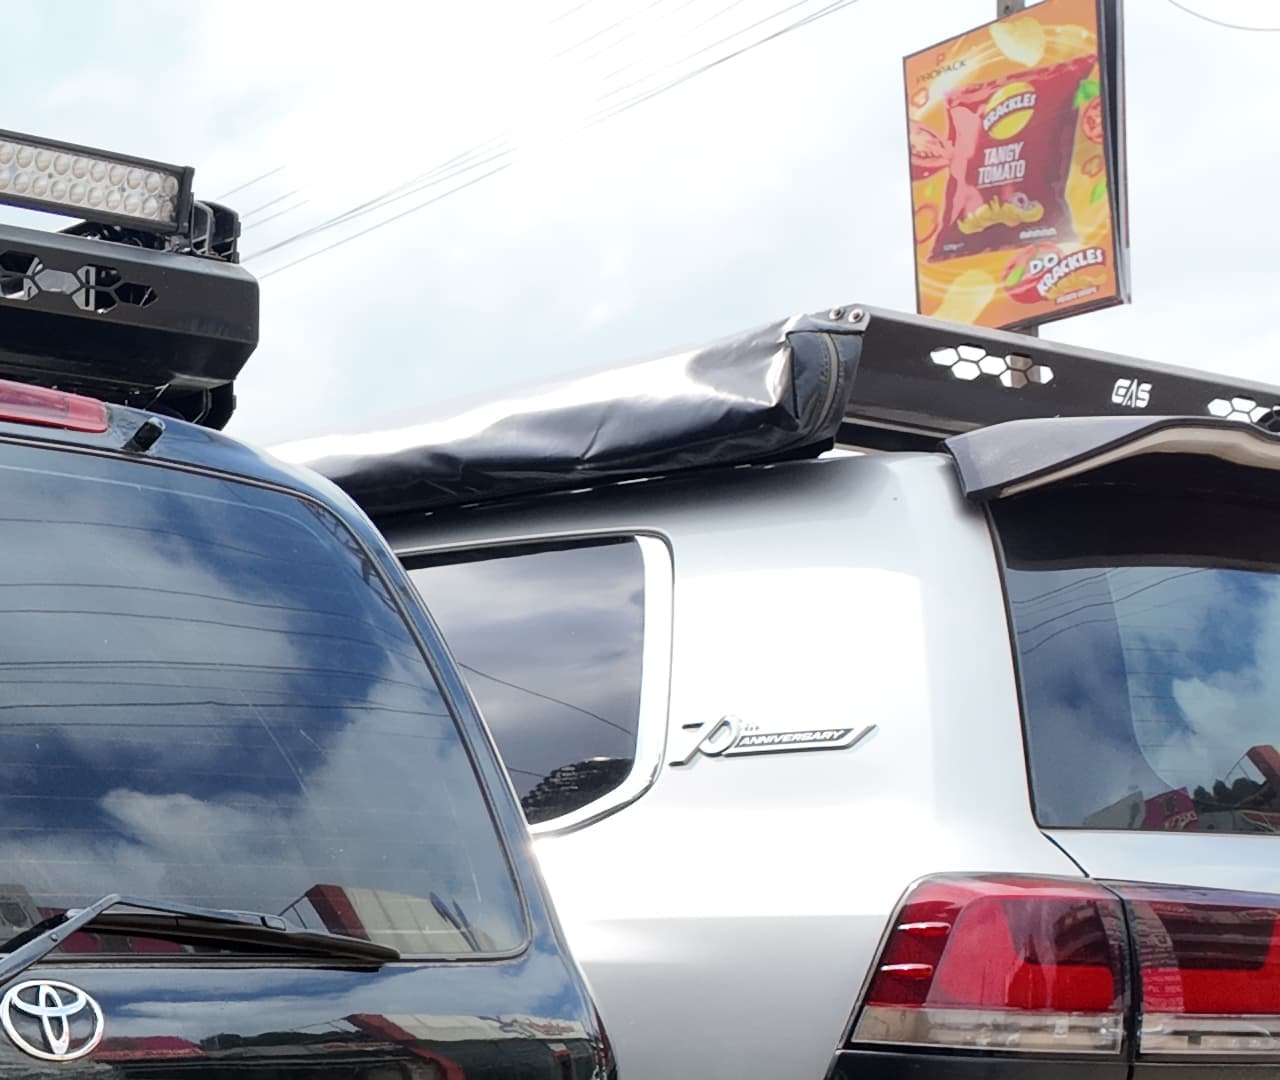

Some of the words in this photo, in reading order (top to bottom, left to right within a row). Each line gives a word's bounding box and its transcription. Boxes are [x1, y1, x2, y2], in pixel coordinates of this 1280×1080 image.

[983, 141, 1024, 164] TANGY
[977, 159, 1025, 185] TOMATO
[1029, 252, 1058, 274] DO
[1036, 248, 1103, 294] KRACKLES
[739, 729, 844, 746] ANNIVERSARY
